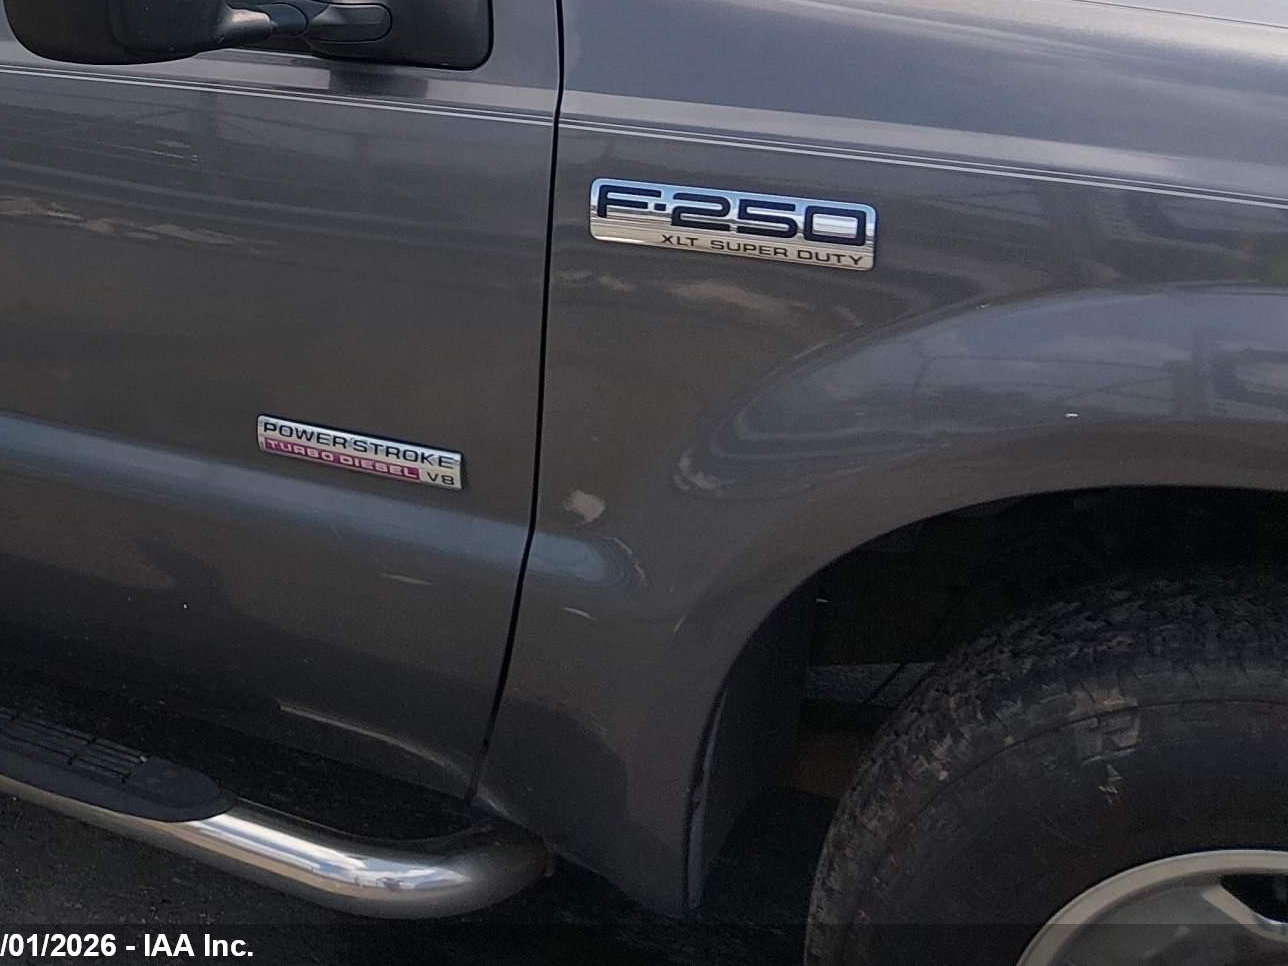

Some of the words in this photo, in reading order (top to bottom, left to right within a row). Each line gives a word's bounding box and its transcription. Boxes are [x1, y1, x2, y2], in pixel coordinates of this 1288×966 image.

[597, 185, 866, 246] F-250
[661, 234, 699, 248] XLT
[710, 239, 789, 258] SUPER
[797, 249, 864, 266] DUTY
[266, 439, 334, 461] TURBO
[339, 454, 418, 479] DIESEL
[426, 471, 455, 486] V8
